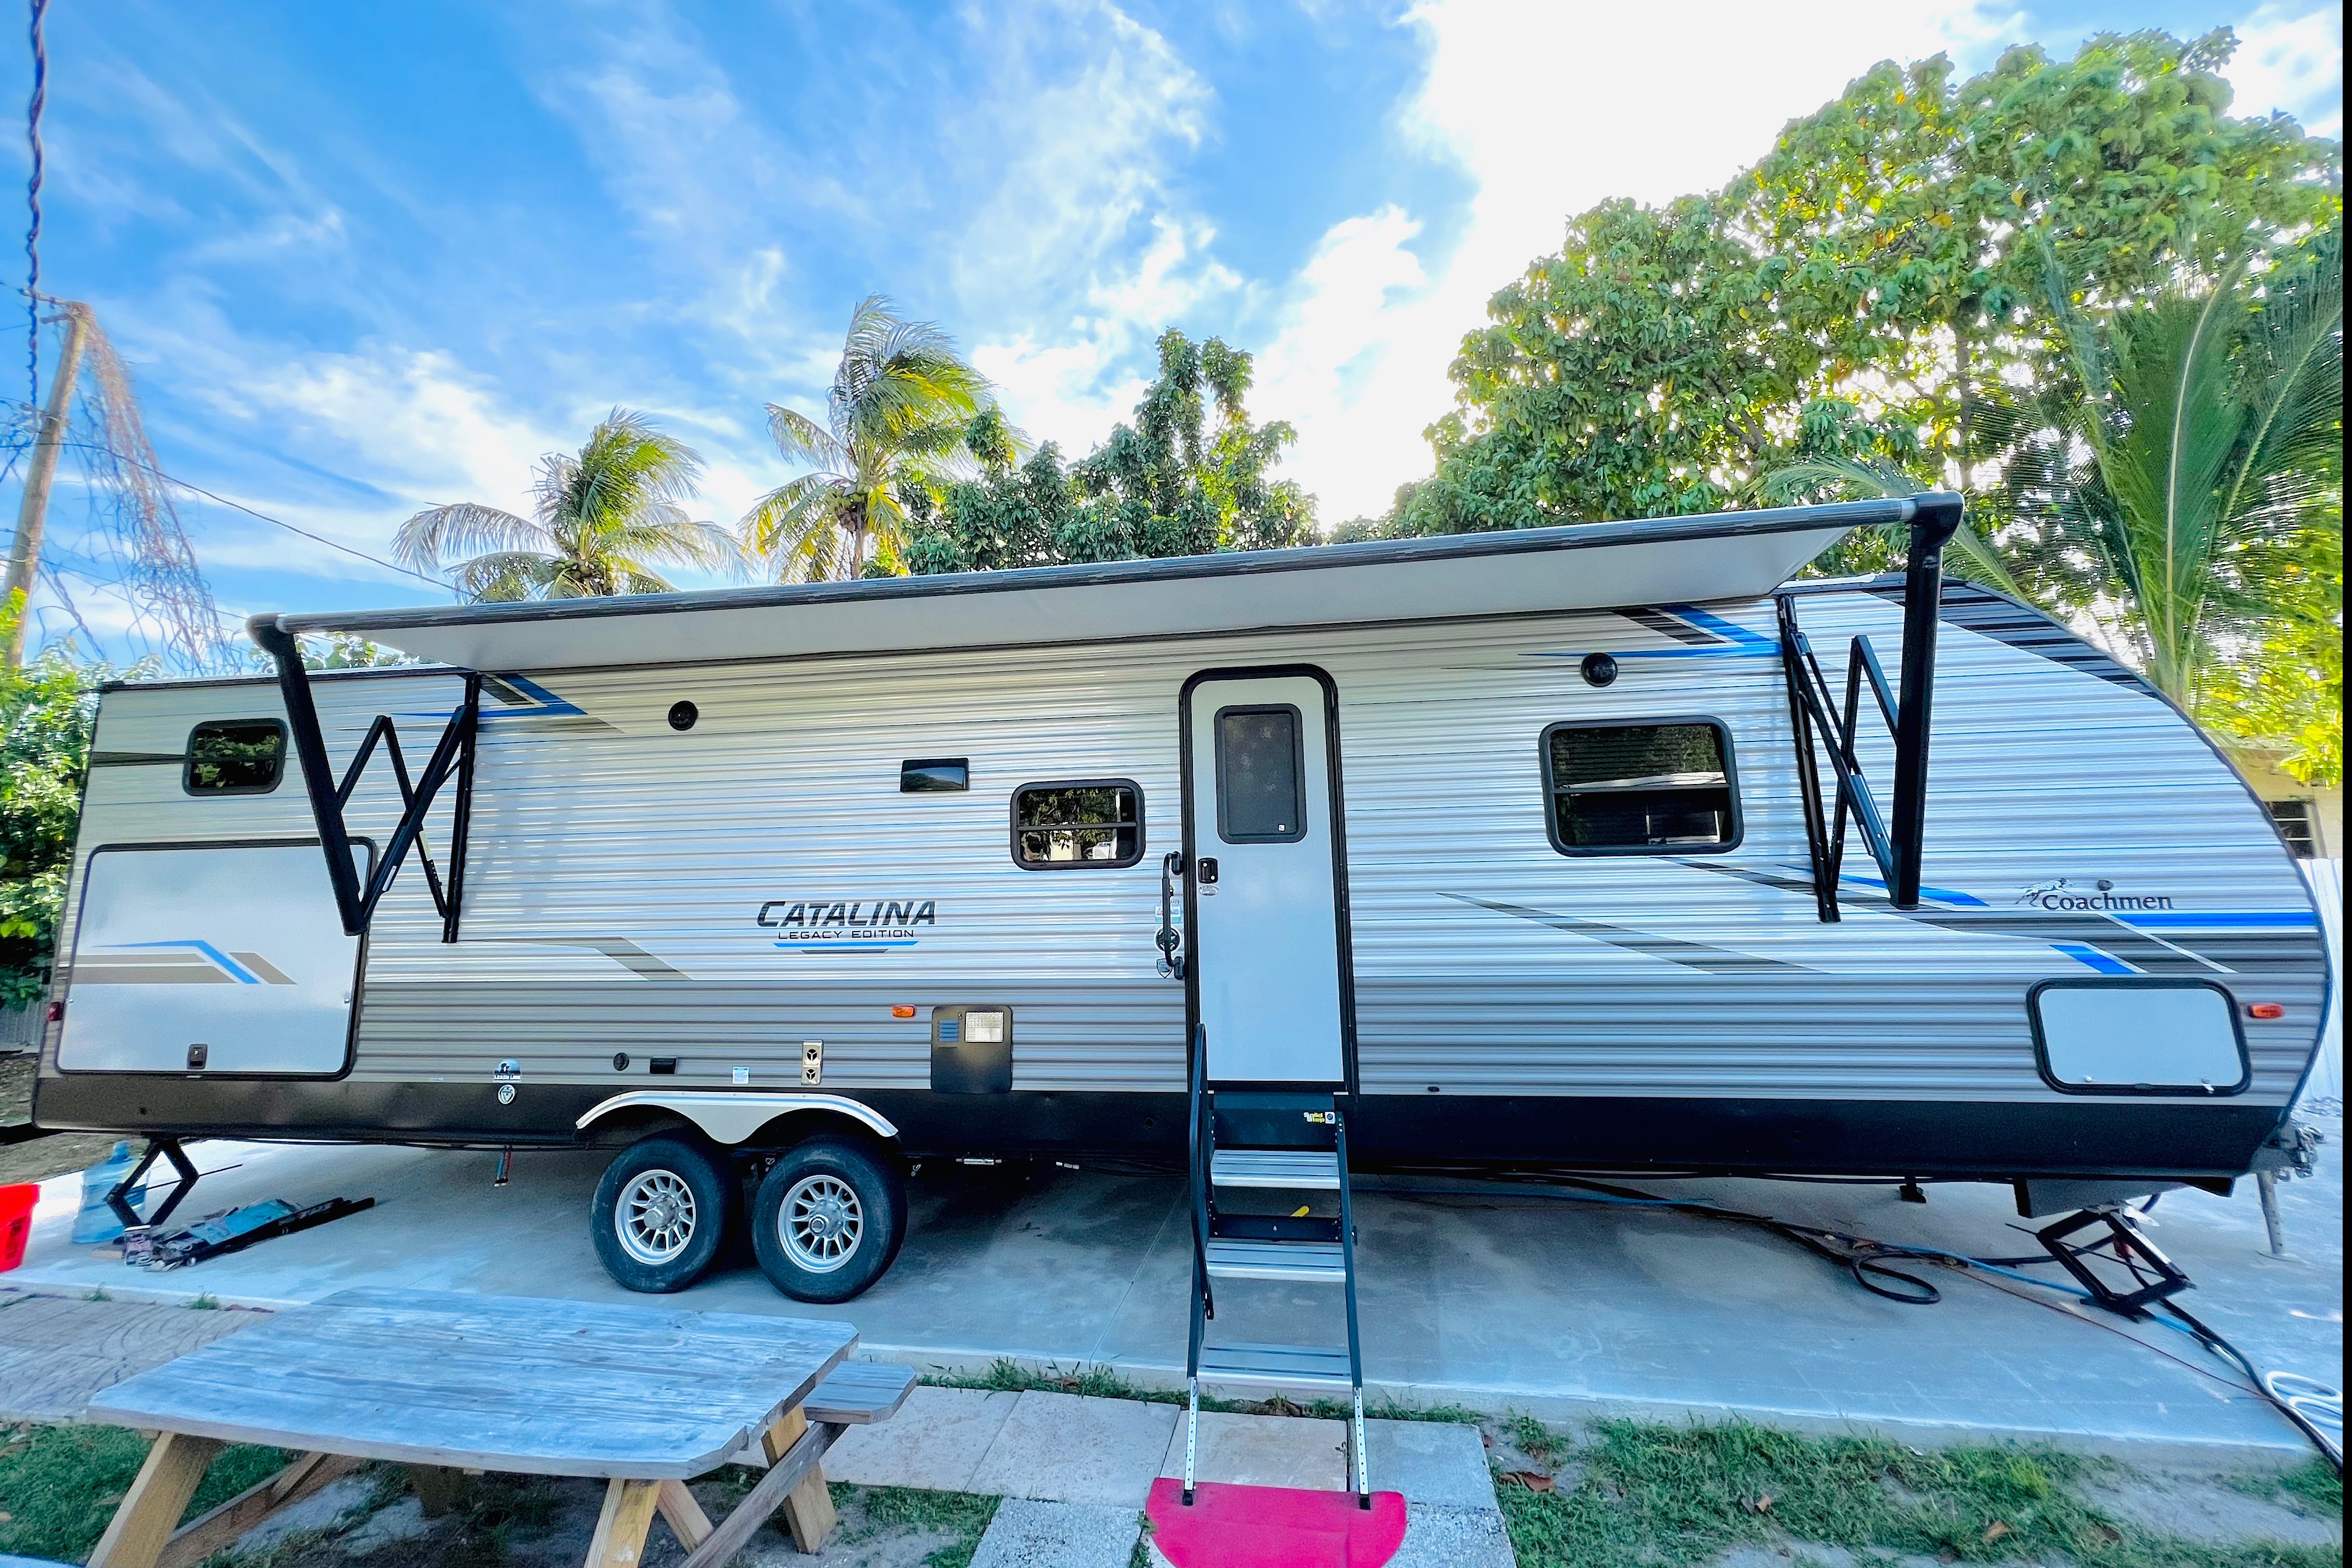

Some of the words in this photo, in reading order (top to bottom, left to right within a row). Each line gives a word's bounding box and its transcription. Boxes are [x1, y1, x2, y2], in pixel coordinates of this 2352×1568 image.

[2042, 892, 2174, 910] Coachmen
[757, 900, 936, 926] CATALINA
[778, 930, 843, 939] LEGACY
[852, 929, 914, 939] EDITION
